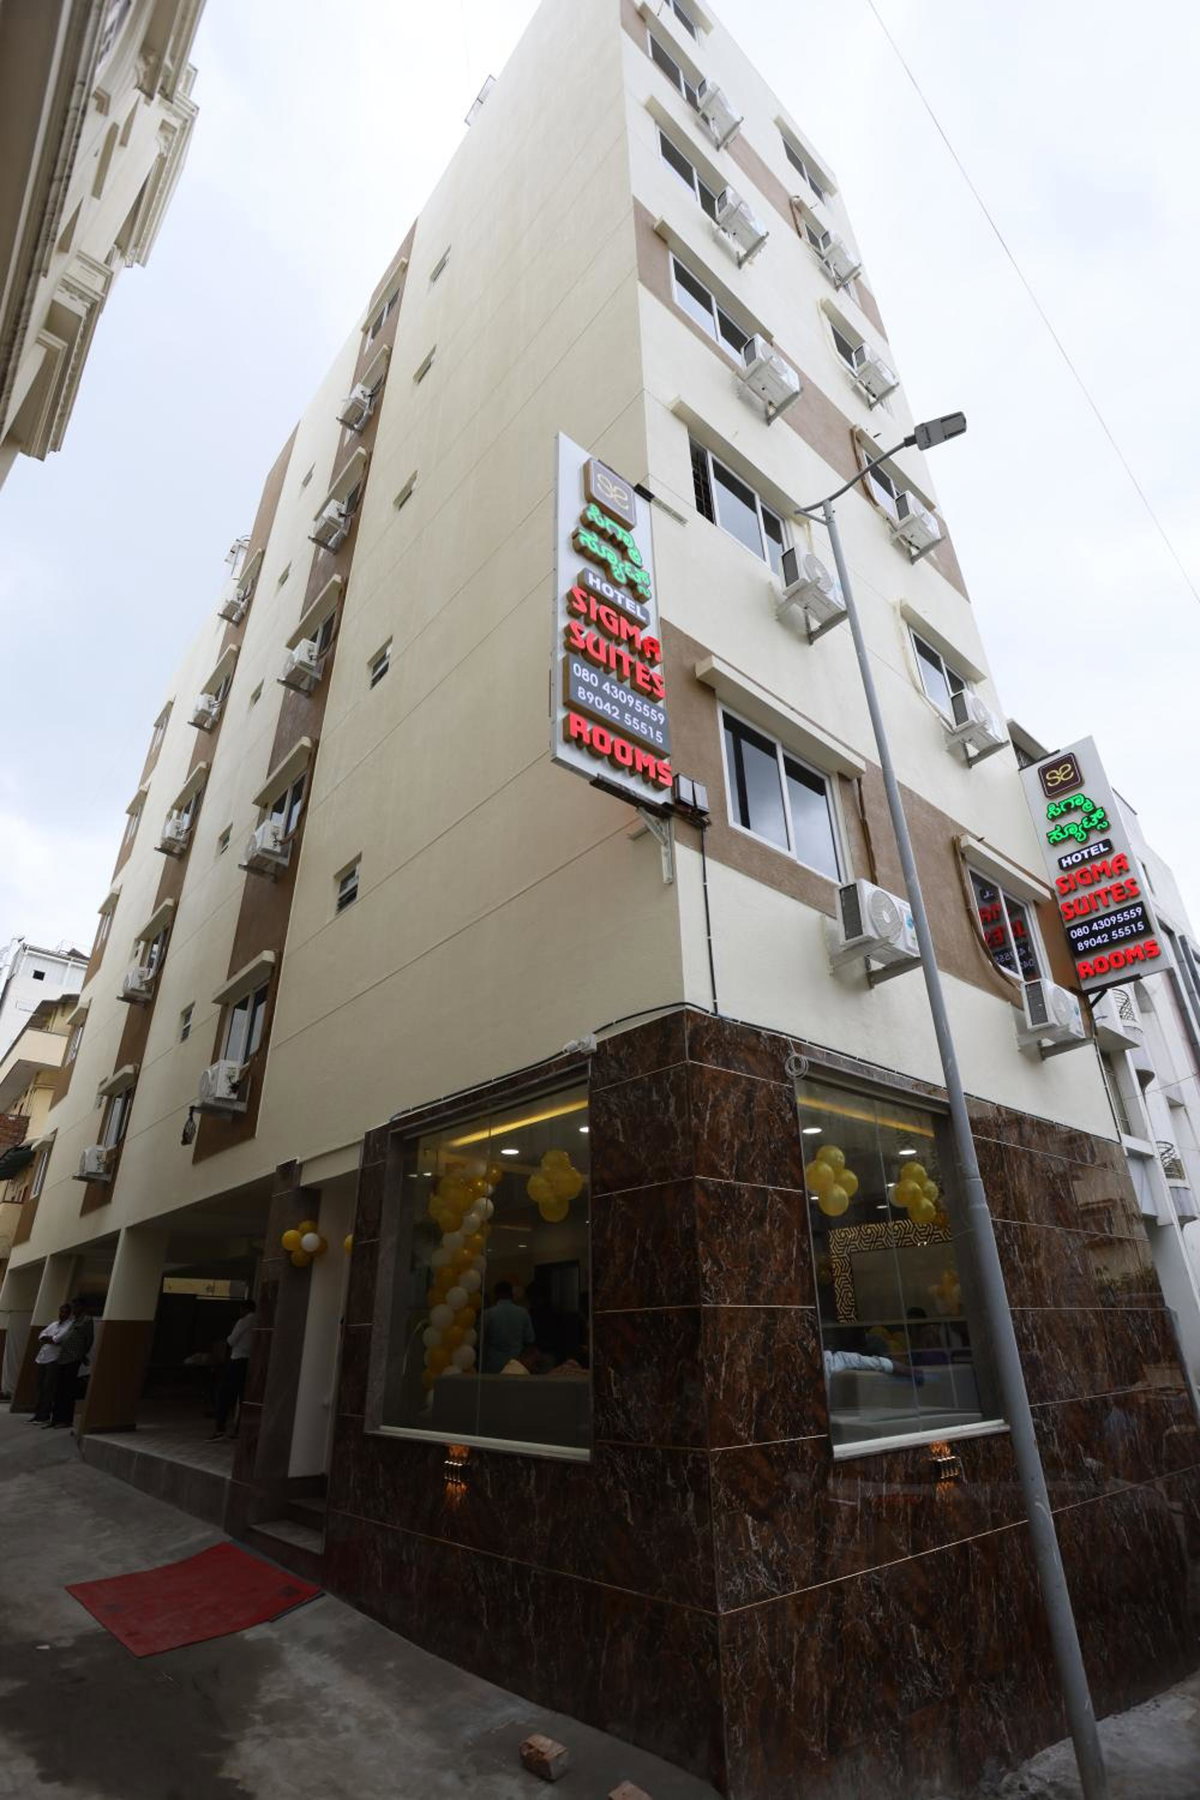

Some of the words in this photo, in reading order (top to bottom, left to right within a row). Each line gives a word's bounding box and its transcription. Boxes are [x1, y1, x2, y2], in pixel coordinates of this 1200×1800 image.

[588, 573, 646, 621] HOTEL
[571, 586, 662, 662] SIGMA
[569, 620, 666, 700] SUITES
[573, 663, 599, 687] 080
[602, 680, 666, 725] 43095559
[577, 686, 621, 720] 89042
[624, 714, 664, 744] 55515
[569, 712, 673, 787] ROOMS
[1055, 853, 1130, 895] SIGMA
[1061, 843, 1109, 868] HOTEL
[1060, 877, 1141, 921] SUITES
[1070, 926, 1090, 939] 080
[1092, 906, 1142, 931] 43095559
[1077, 934, 1110, 951] 89042
[1112, 921, 1145, 940] 55515
[1077, 939, 1161, 979] ROOMS
